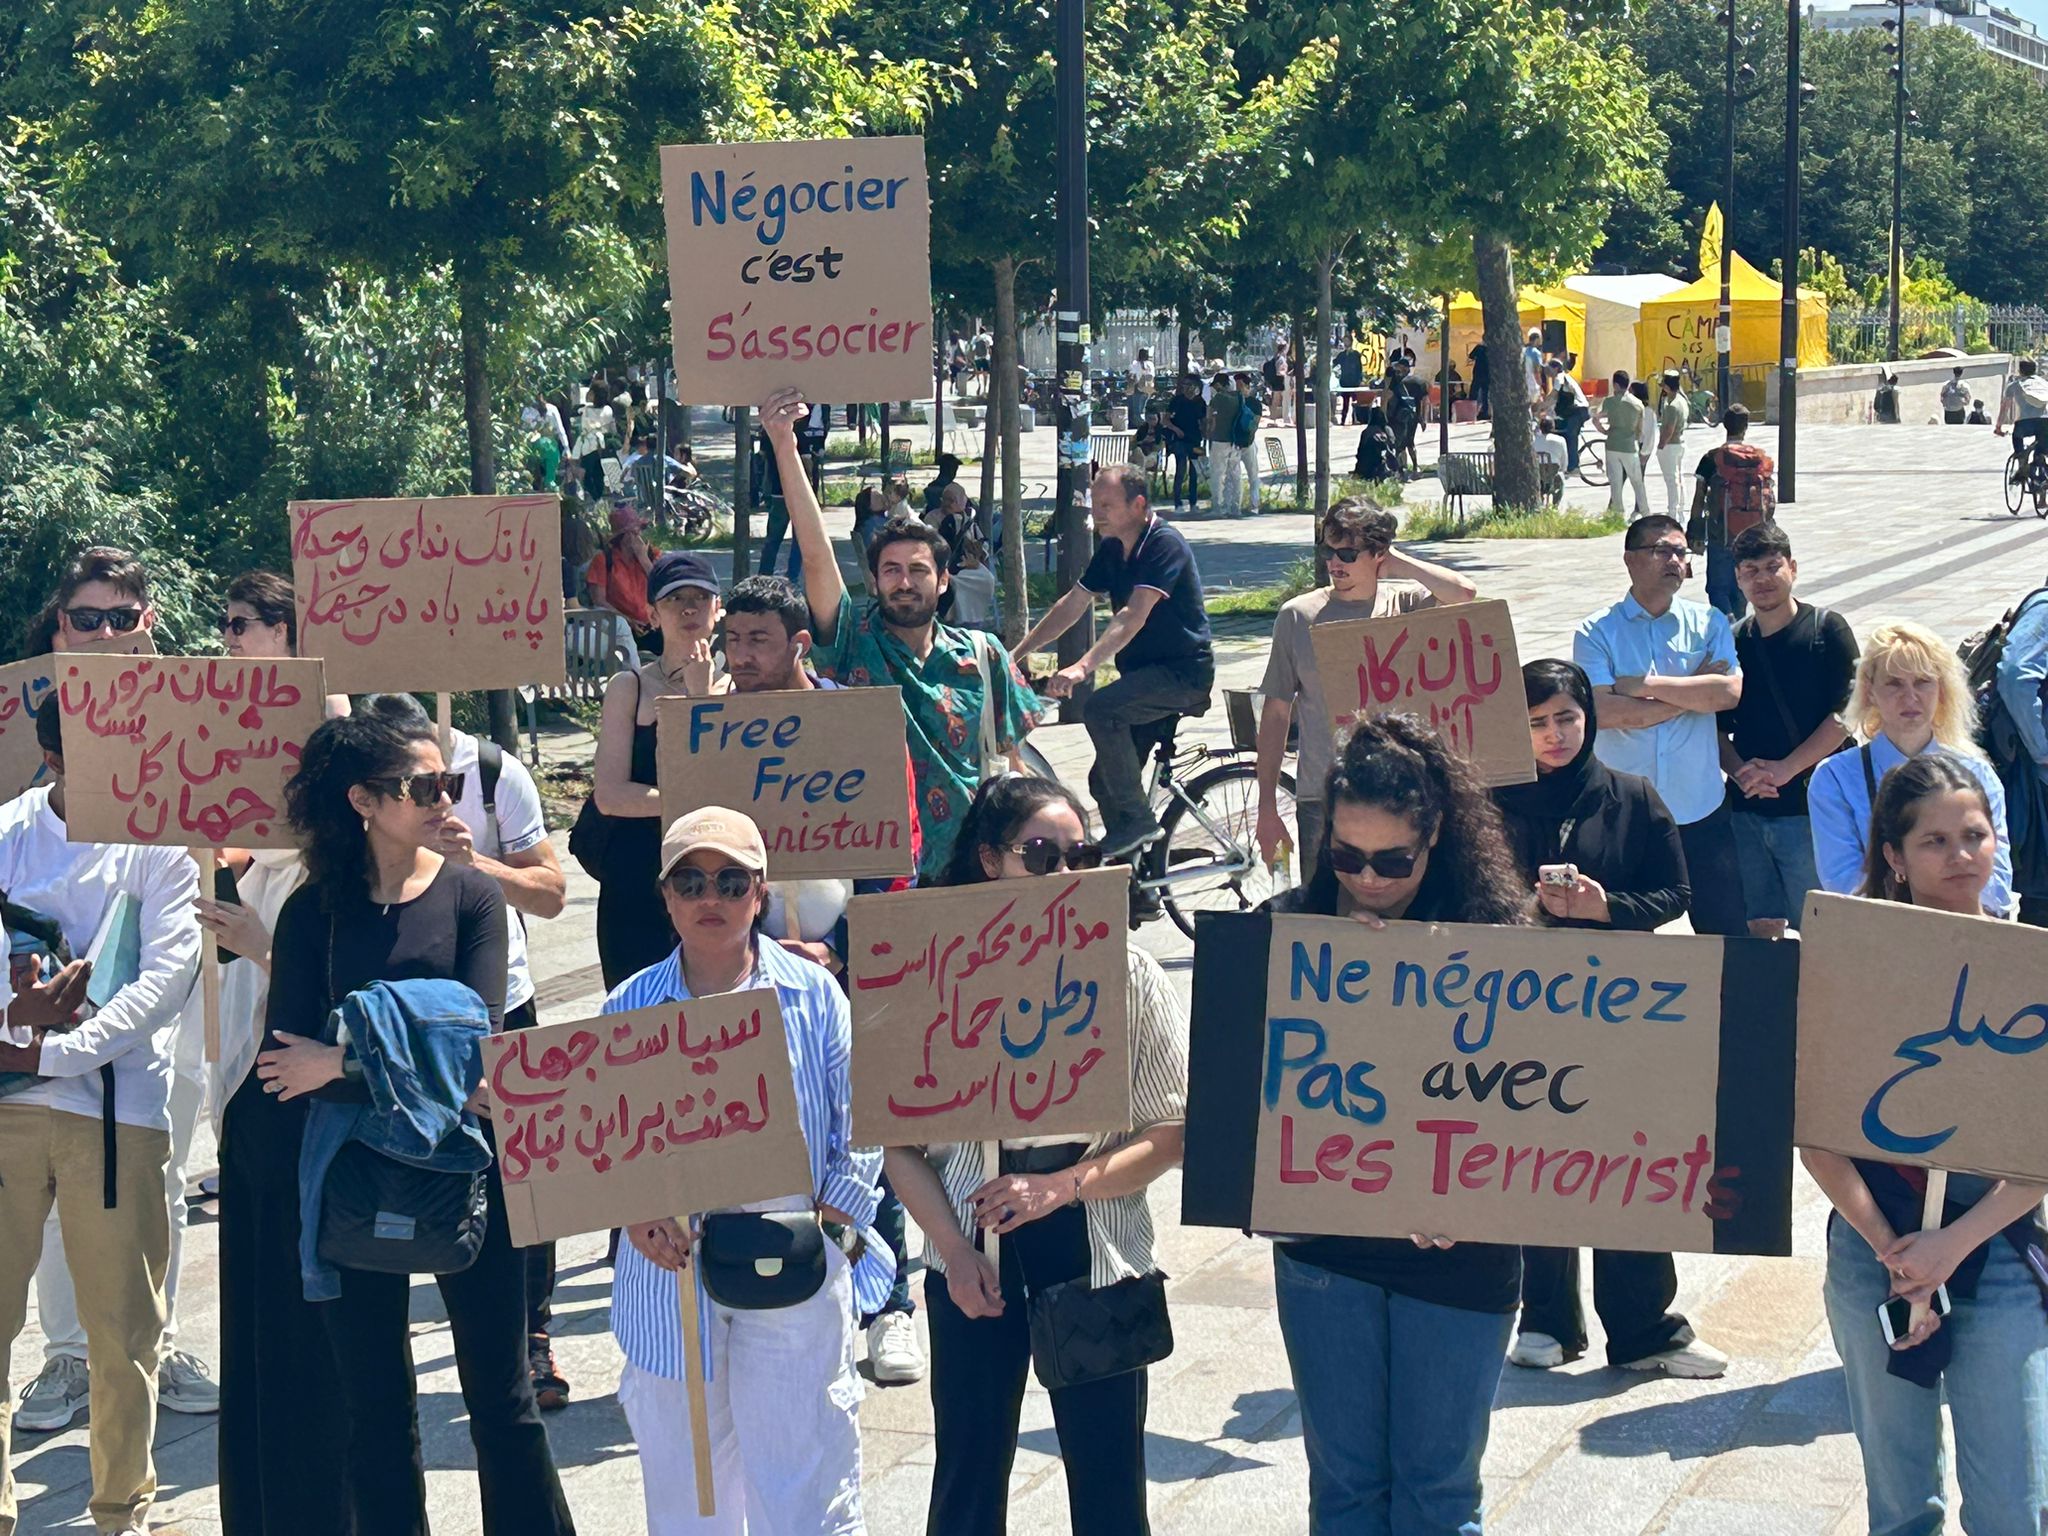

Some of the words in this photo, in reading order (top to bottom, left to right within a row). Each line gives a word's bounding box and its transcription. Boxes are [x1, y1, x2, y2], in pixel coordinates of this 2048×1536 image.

[690, 165, 909, 246] Négocier
[706, 302, 926, 362] S'associer
[419, 565, 460, 637] باد
[169, 659, 301, 717] طالبان
[688, 702, 803, 755] Free
[126, 783, 277, 846] جهان
[752, 756, 867, 804] Free
[937, 898, 1018, 1004] محکوم
[1017, 878, 1111, 967] مذاکره
[856, 932, 938, 991] است
[1288, 940, 1372, 1005] Ne
[1391, 950, 1688, 1055] négociez
[604, 1008, 762, 1076] سیاست
[1000, 953, 1100, 1060] وطن
[887, 1061, 1002, 1118] است
[1010, 1025, 1107, 1122] خون
[1263, 1018, 1388, 1125] Pas
[1420, 1058, 1591, 1115] avec
[665, 1073, 770, 1146] لعنت
[1278, 1114, 1396, 1195] Les
[1415, 1118, 1744, 1221] Terrorists
